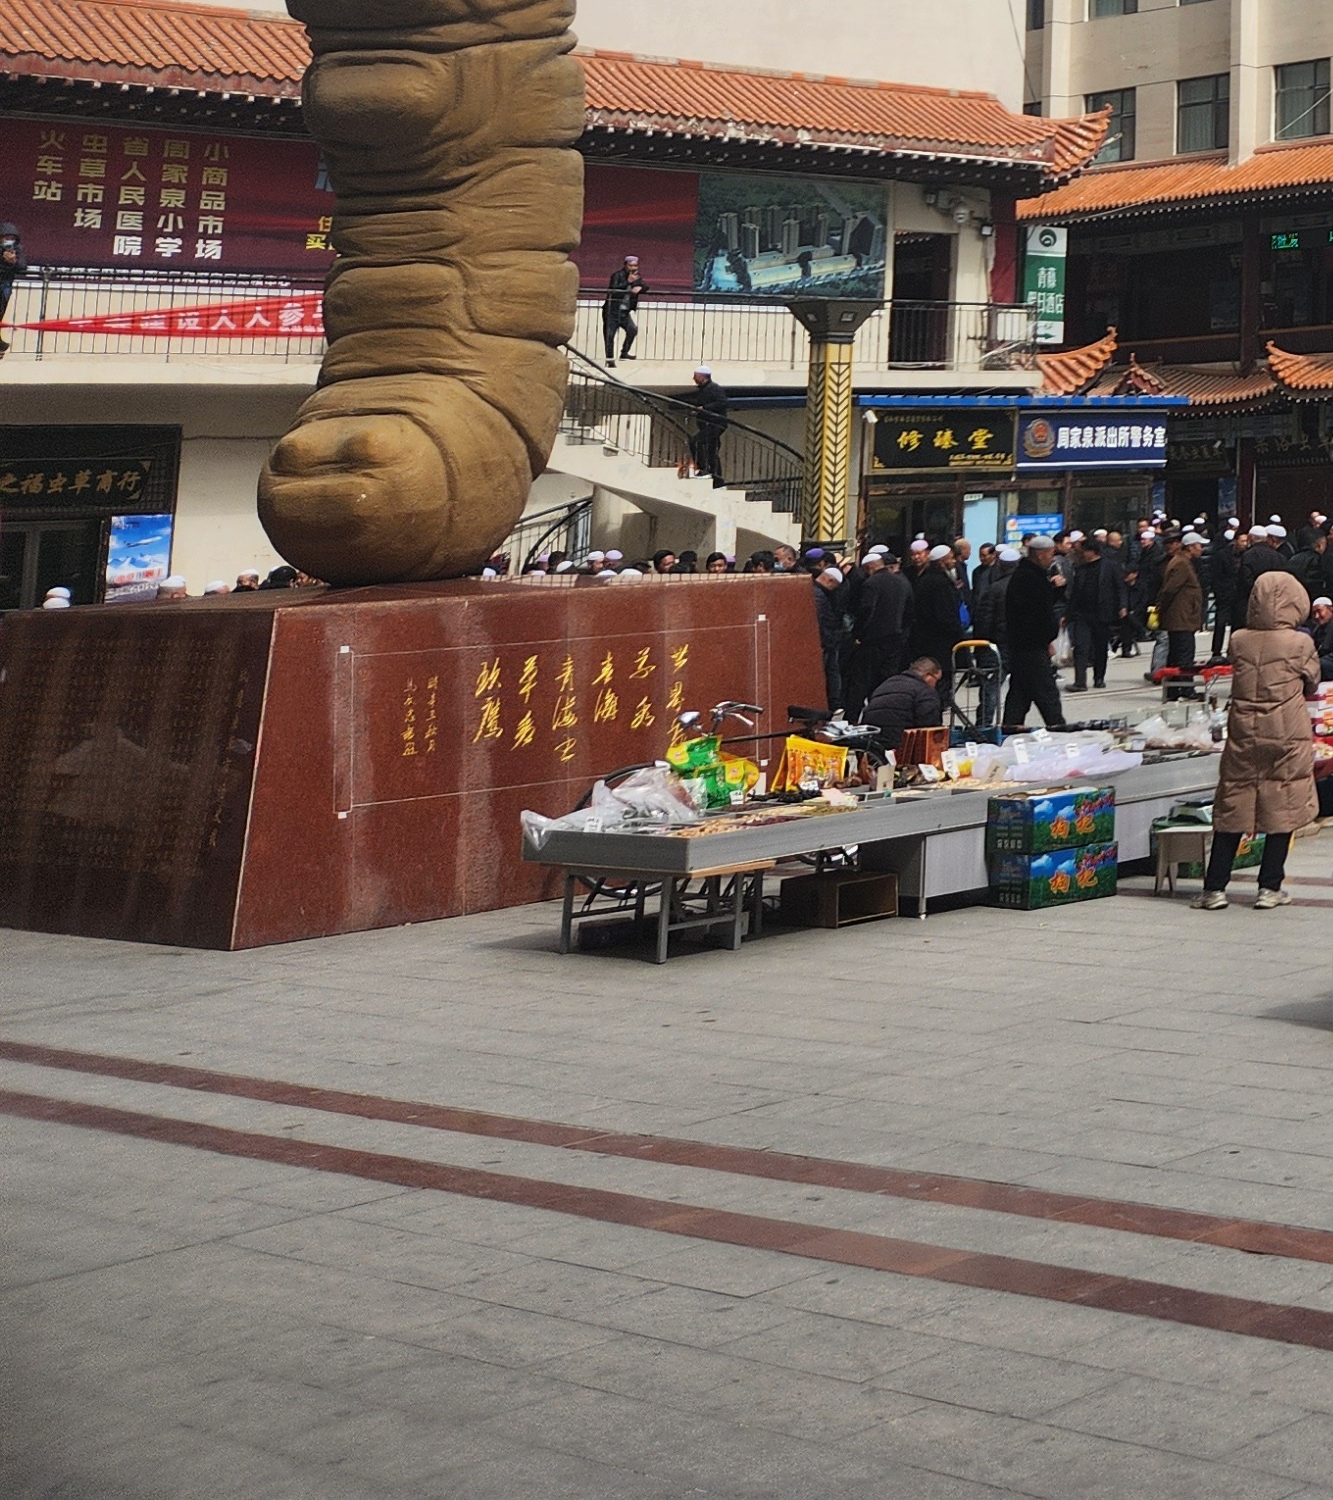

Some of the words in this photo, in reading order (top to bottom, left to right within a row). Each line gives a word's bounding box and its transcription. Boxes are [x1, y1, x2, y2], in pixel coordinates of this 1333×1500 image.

[32, 129, 67, 202] 火车站
[73, 133, 108, 230] 虫草市场
[112, 136, 151, 258] 省人民医院
[154, 138, 192, 258] 周家泉小学
[194, 141, 231, 261] 小商品市场
[1056, 425, 1168, 450] 周家泉派出所警务室
[1049, 813, 1097, 840] 枸杞
[1048, 866, 1099, 894] 枸杞
